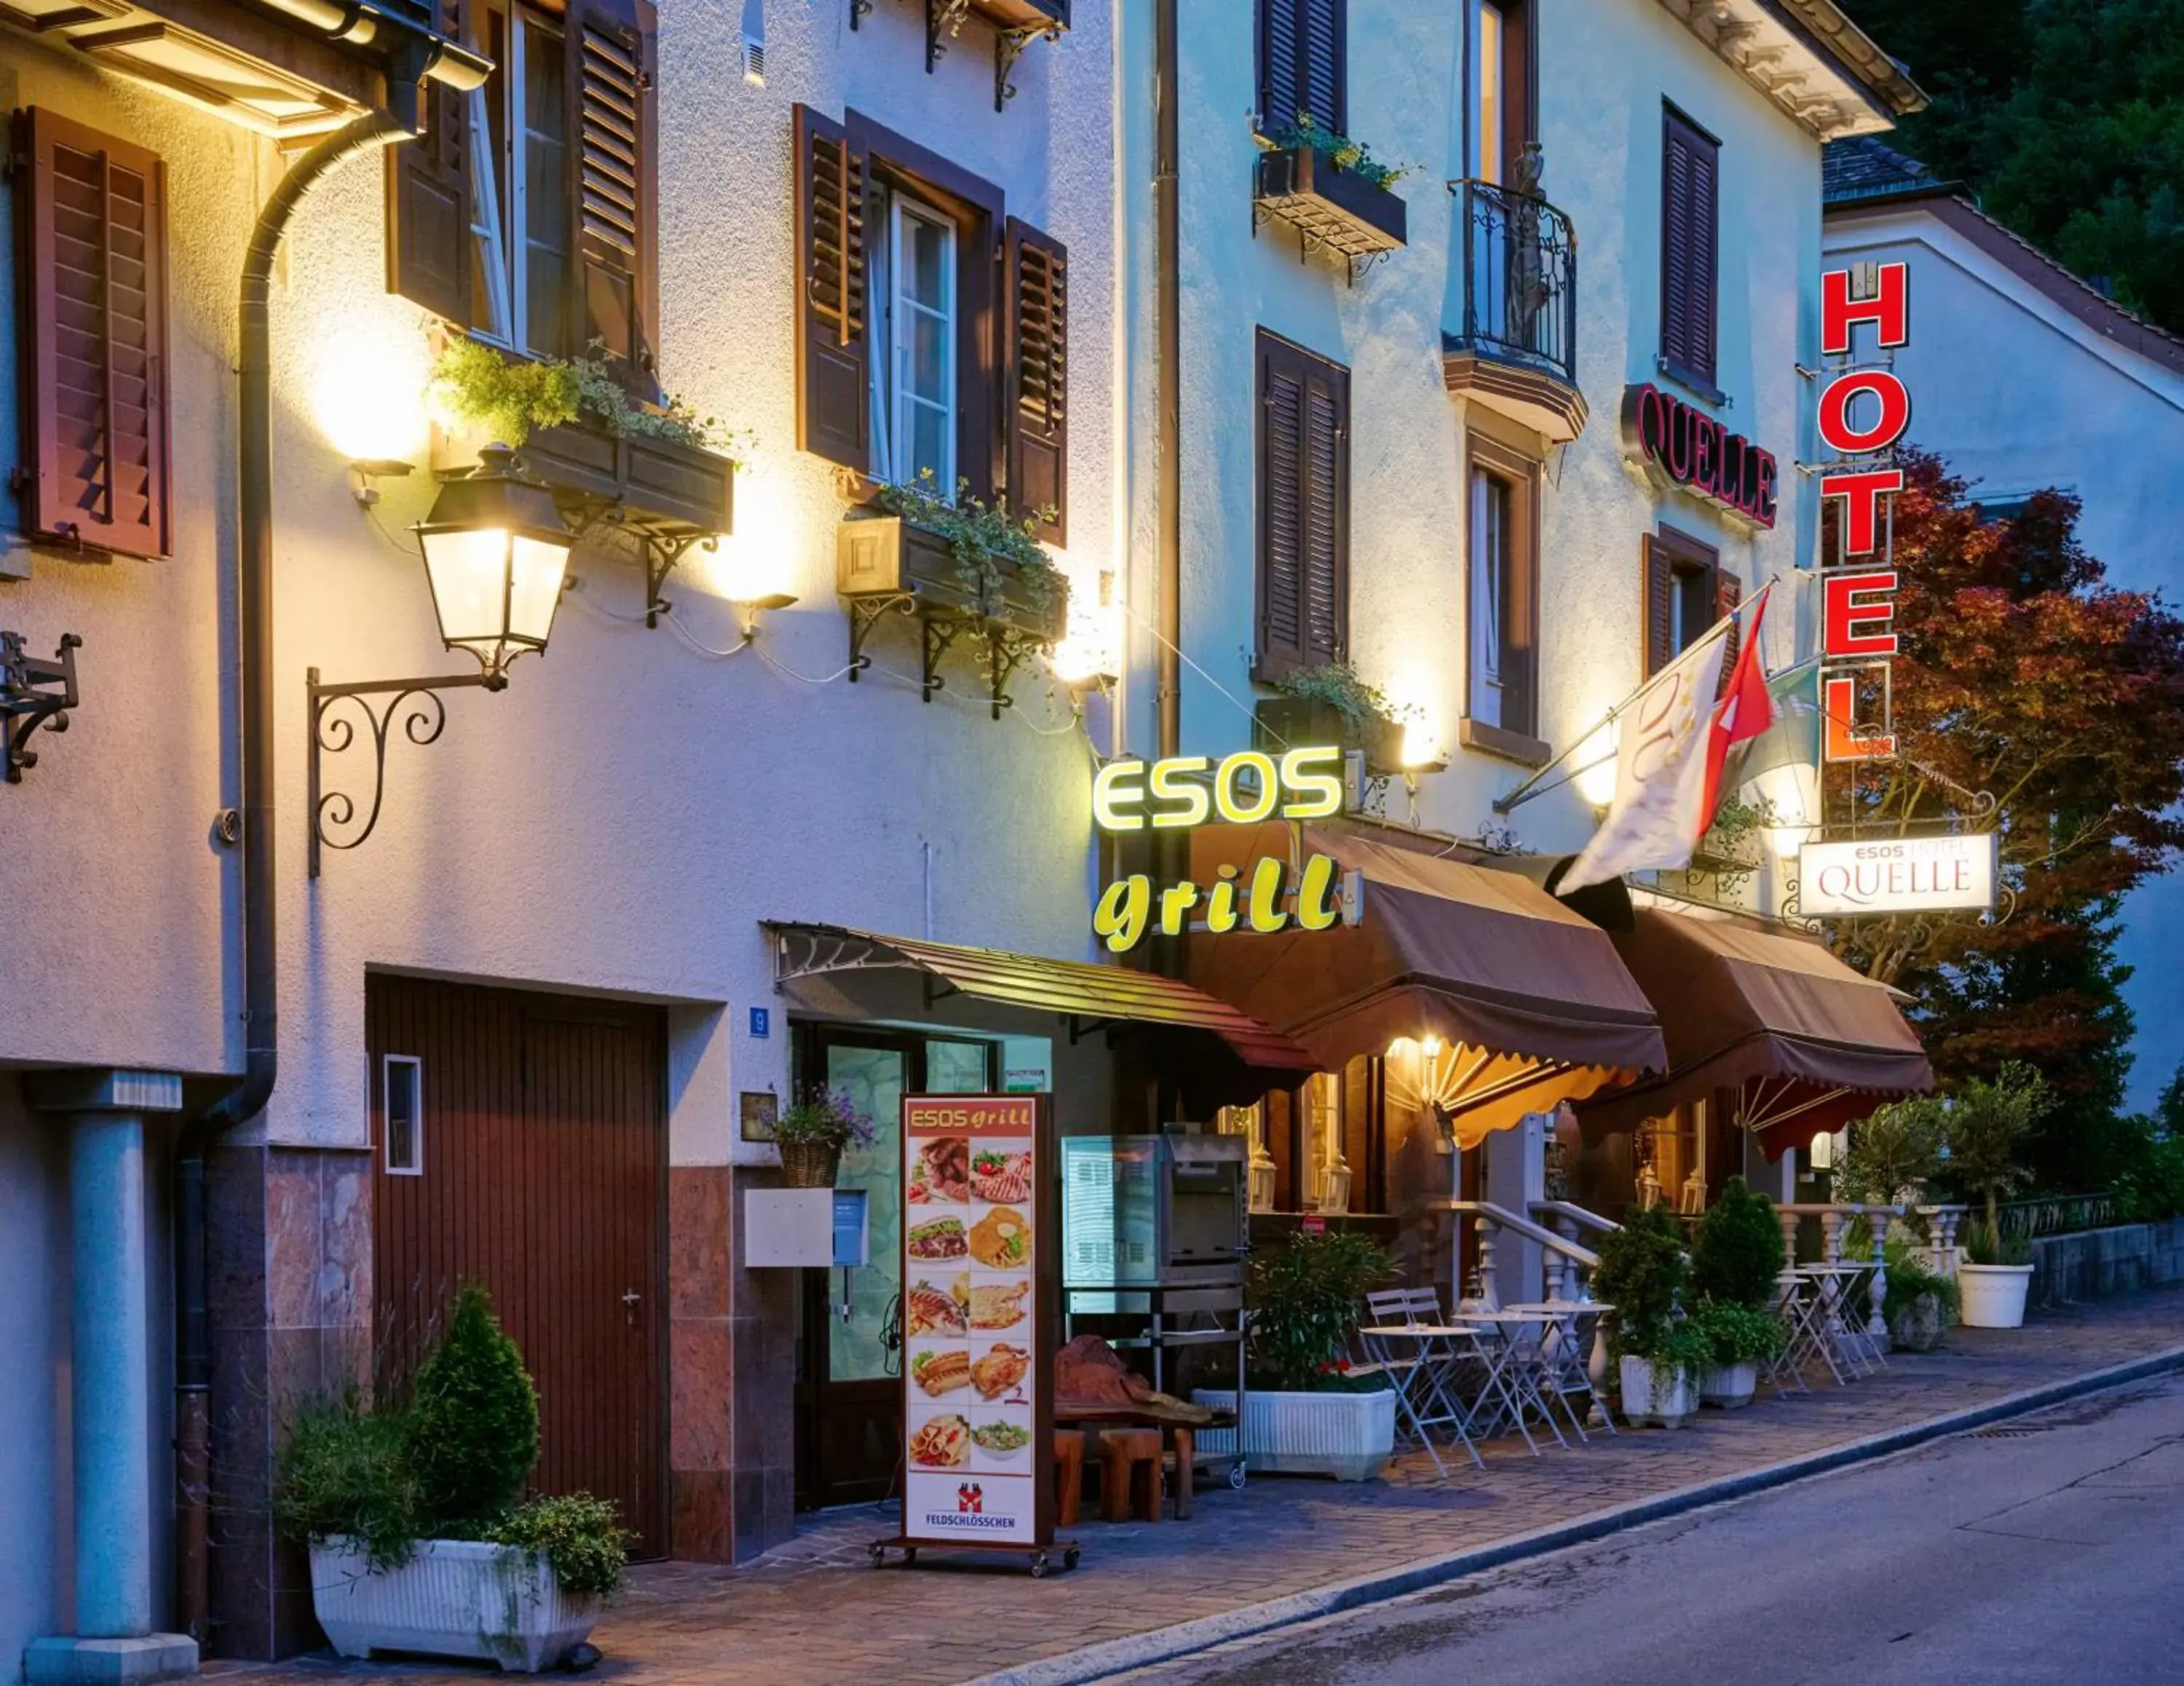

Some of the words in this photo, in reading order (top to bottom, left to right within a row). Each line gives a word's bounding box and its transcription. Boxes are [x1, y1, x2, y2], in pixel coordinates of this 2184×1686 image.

[1637, 381, 1776, 529] QUELLE
[1817, 261, 1909, 762] HOTEL
[1093, 746, 1342, 831] ESOS
[1855, 844, 1905, 859] ESOS
[1911, 839, 1967, 857] HOTEL
[1093, 853, 1337, 952] grill
[1819, 858, 1971, 905] QUELLE
[756, 1012, 764, 1032] 9
[911, 1109, 968, 1128] ESOS
[970, 1108, 1030, 1128] grill
[925, 1513, 1016, 1528] FELDSCHLÖSSCHEN
